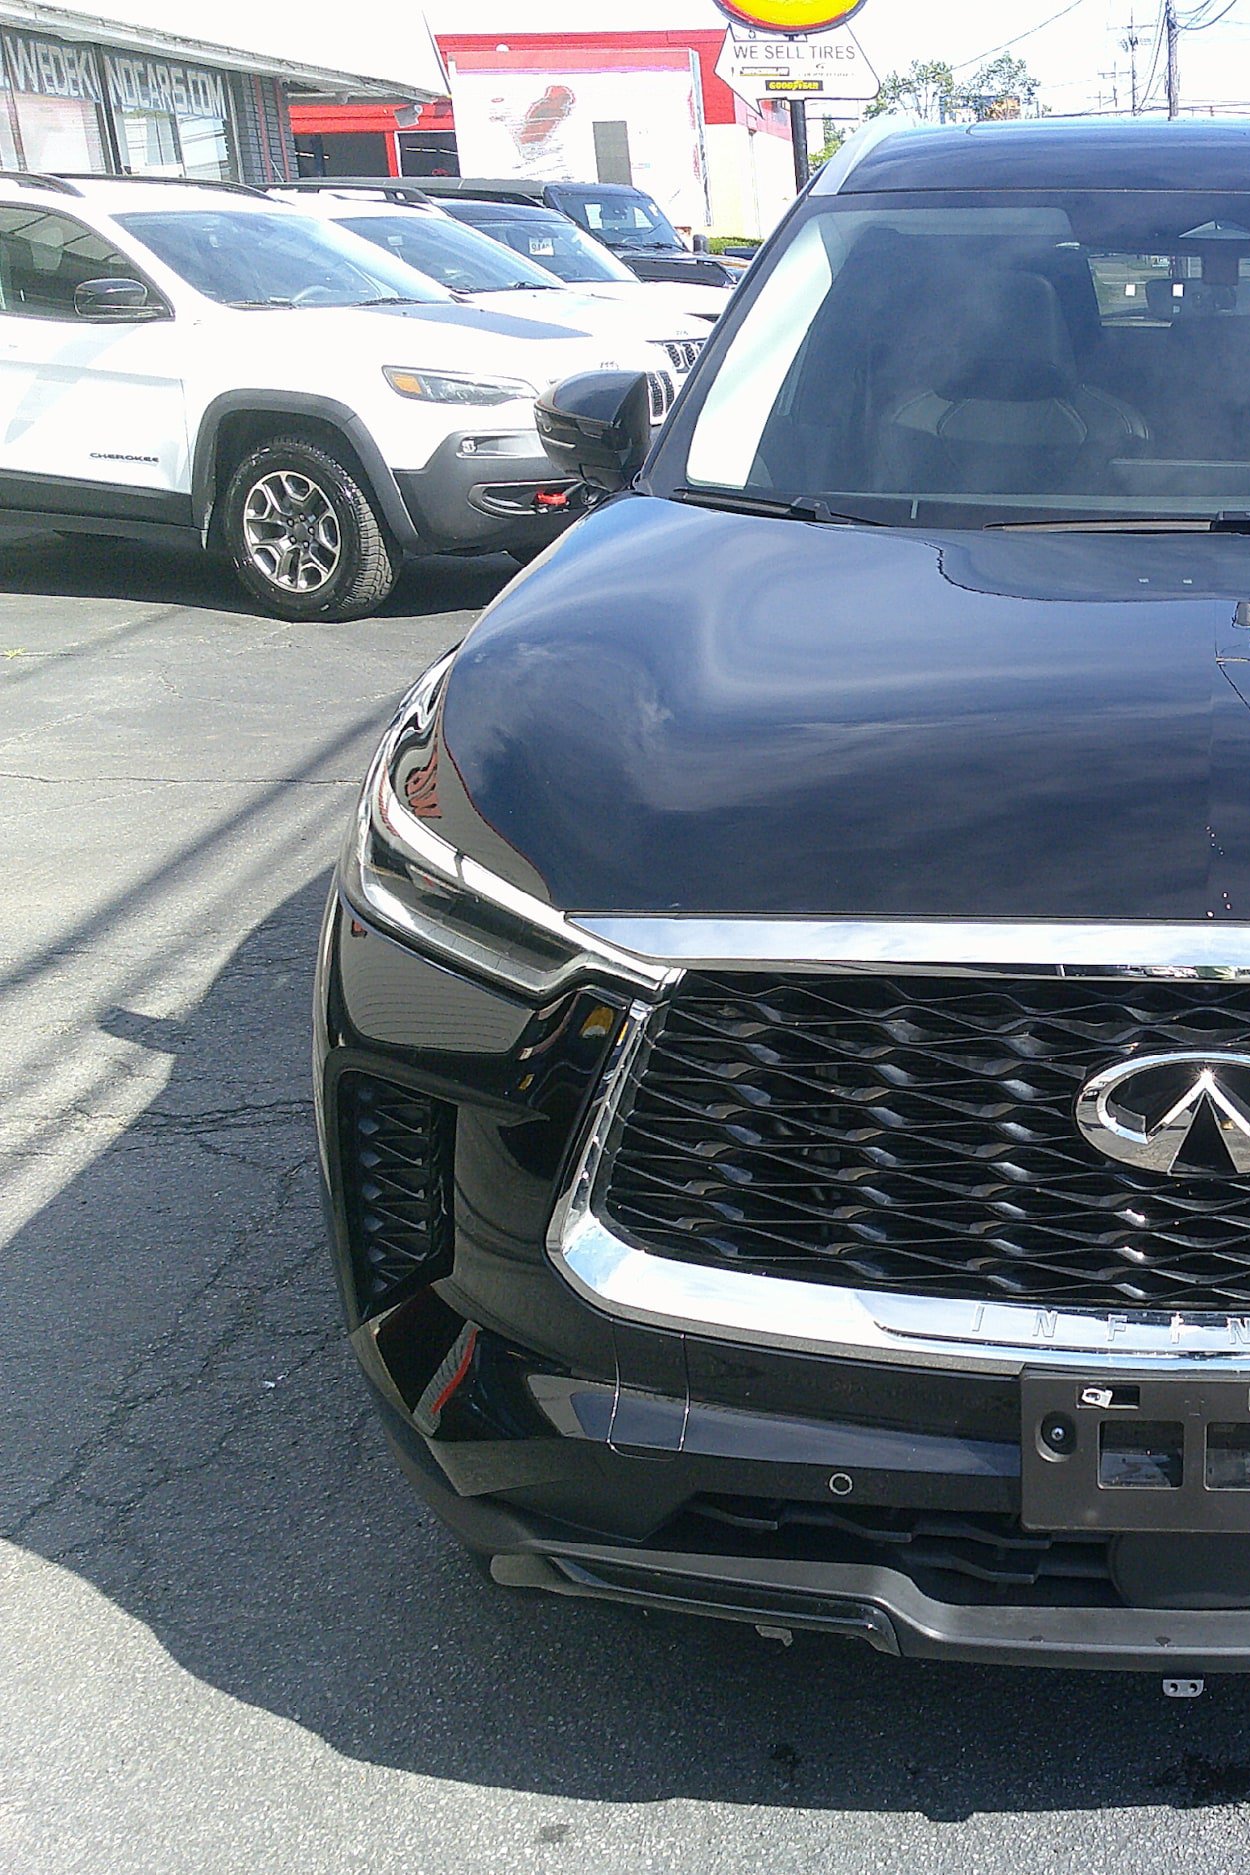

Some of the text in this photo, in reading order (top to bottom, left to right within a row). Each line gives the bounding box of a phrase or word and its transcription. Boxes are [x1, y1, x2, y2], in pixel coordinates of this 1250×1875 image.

[733, 45, 856, 60] WE SELL TIRES
[89, 452, 160, 463] CHEROKEE
